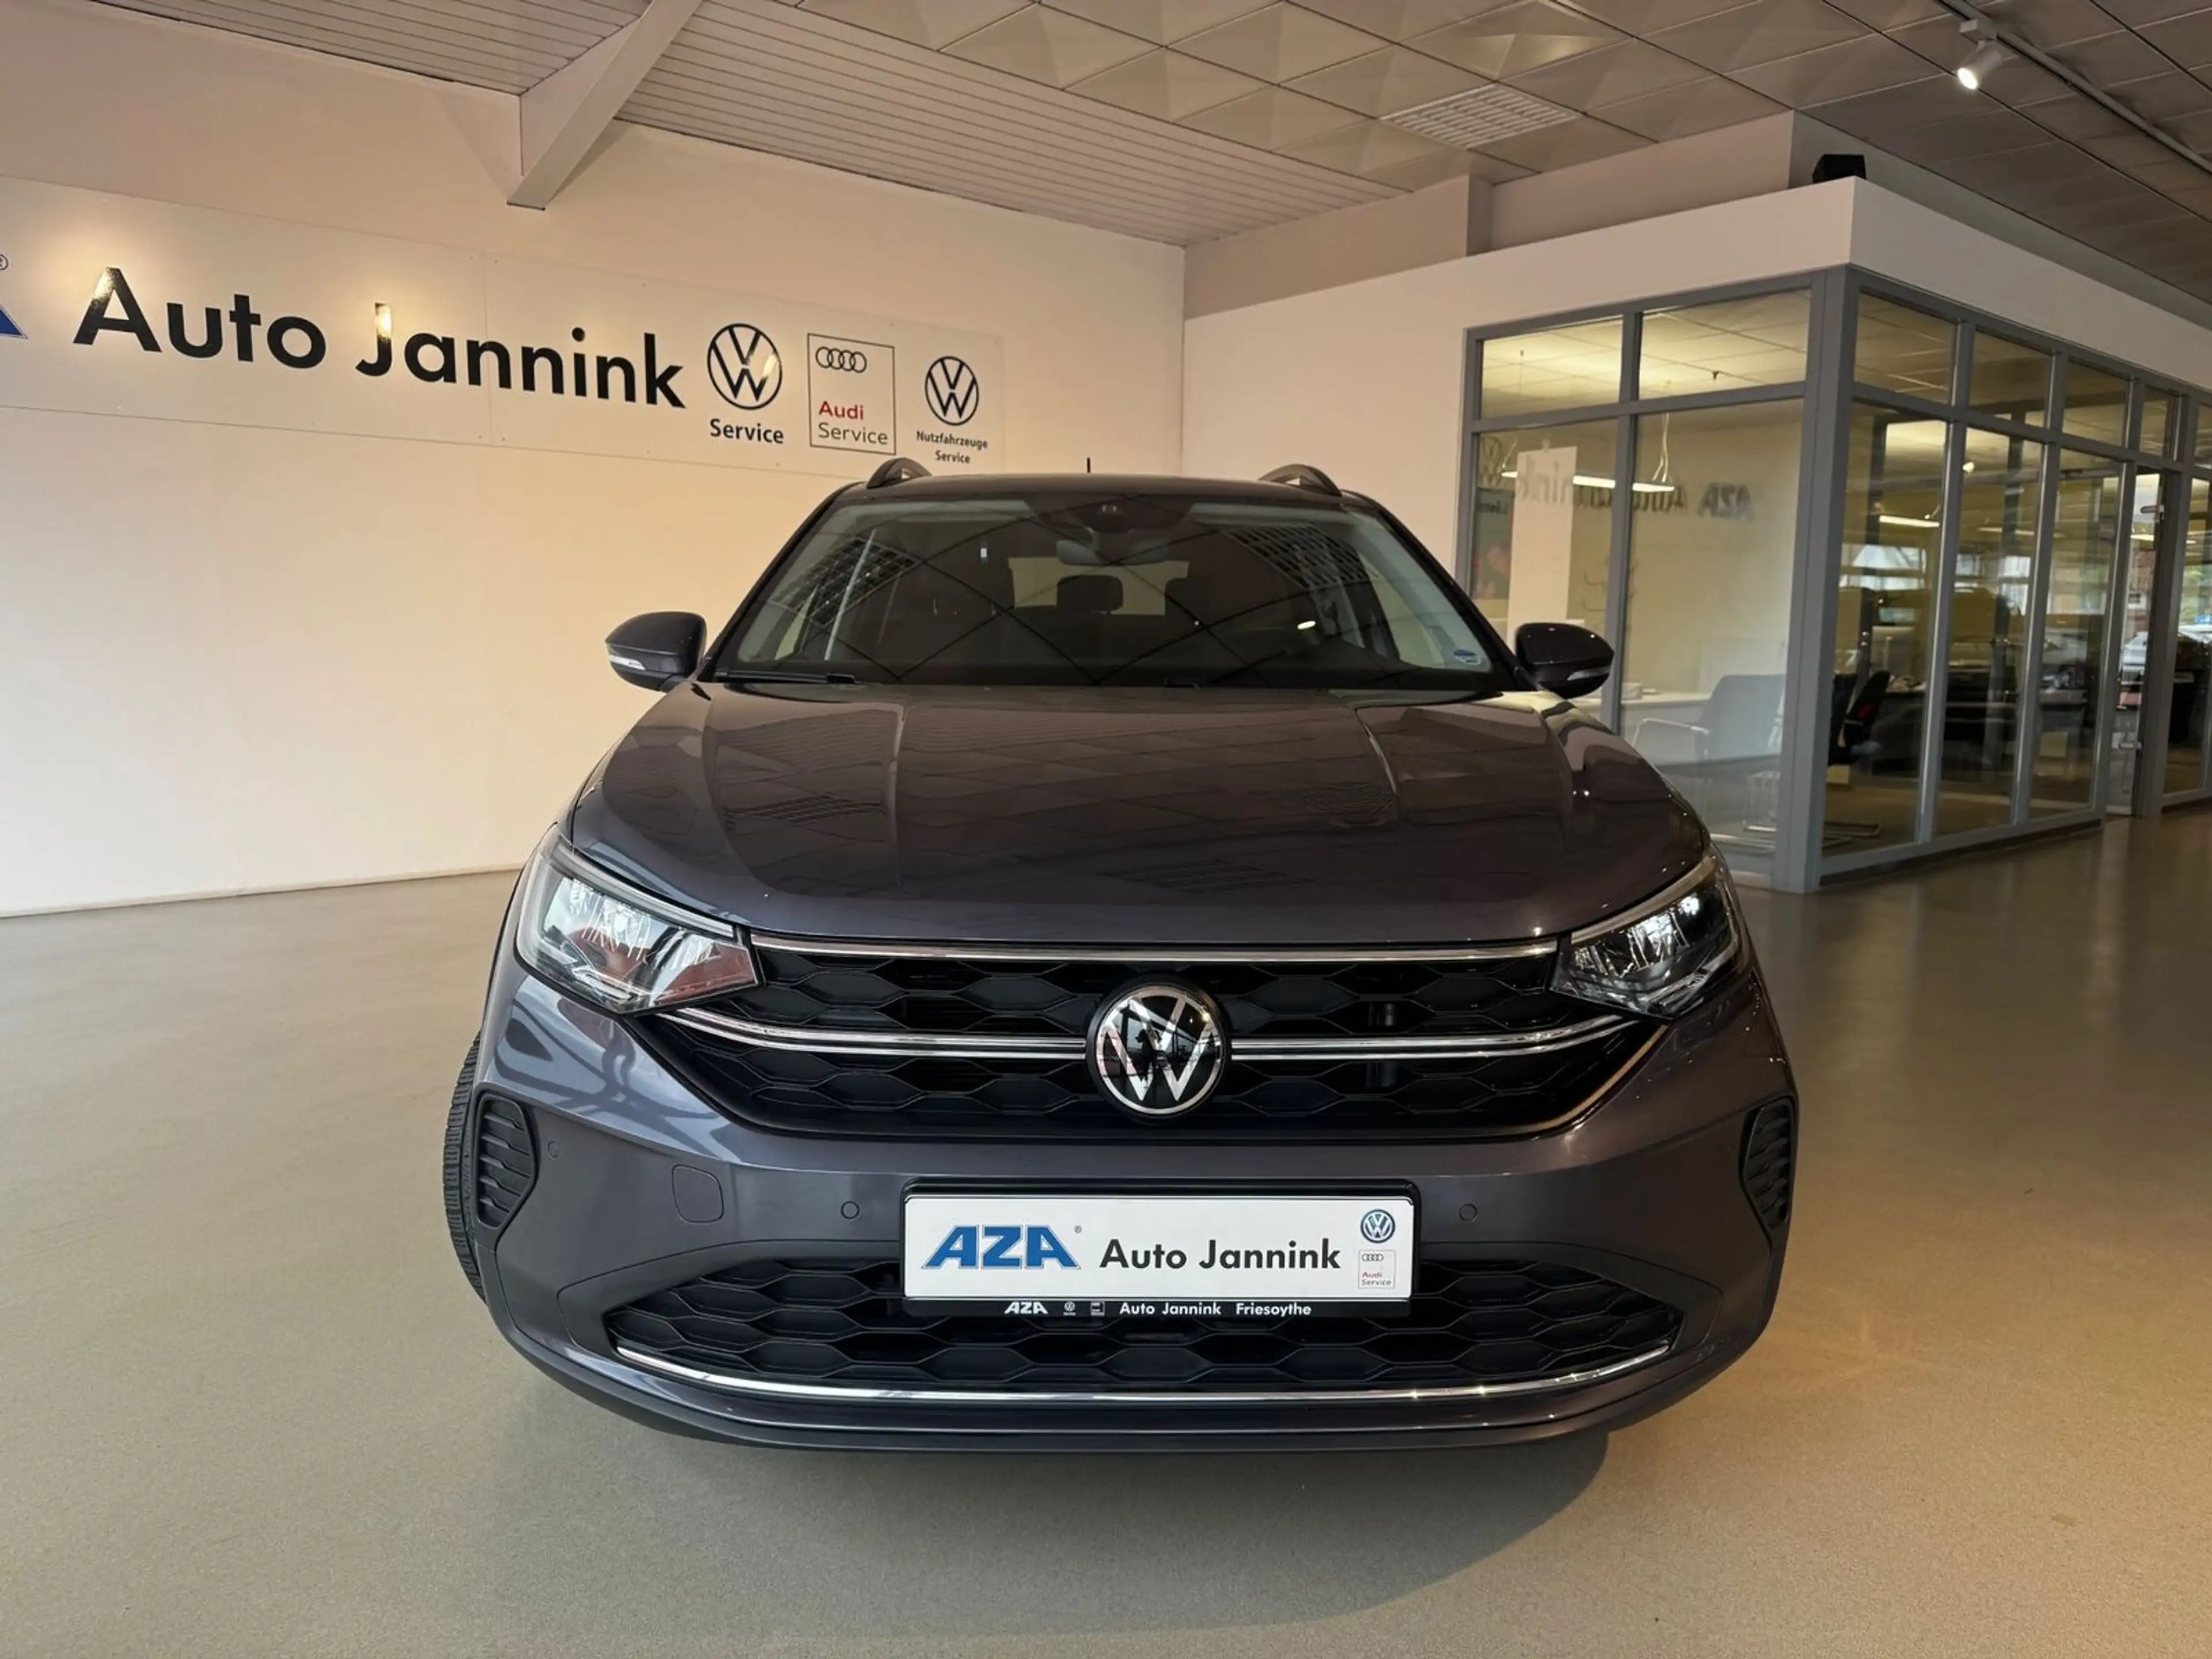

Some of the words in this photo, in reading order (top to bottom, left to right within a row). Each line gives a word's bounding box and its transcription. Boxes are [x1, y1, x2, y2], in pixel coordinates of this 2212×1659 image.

[73, 267, 327, 369] Auto
[355, 302, 686, 409] Jannink
[819, 401, 864, 421] Audi
[710, 419, 784, 444] Service
[818, 422, 888, 445] Service
[916, 430, 988, 450] Nutzfahrzeuge
[935, 450, 971, 464] Service
[921, 1225, 1082, 1270] AZA
[1100, 1238, 1187, 1268] Auto
[1199, 1238, 1341, 1268] Jannink
[1003, 1301, 1048, 1315] AZA
[1119, 1302, 1155, 1315] Auto
[1162, 1302, 1221, 1315] Jannink
[1236, 1302, 1312, 1318] Friesoythe
